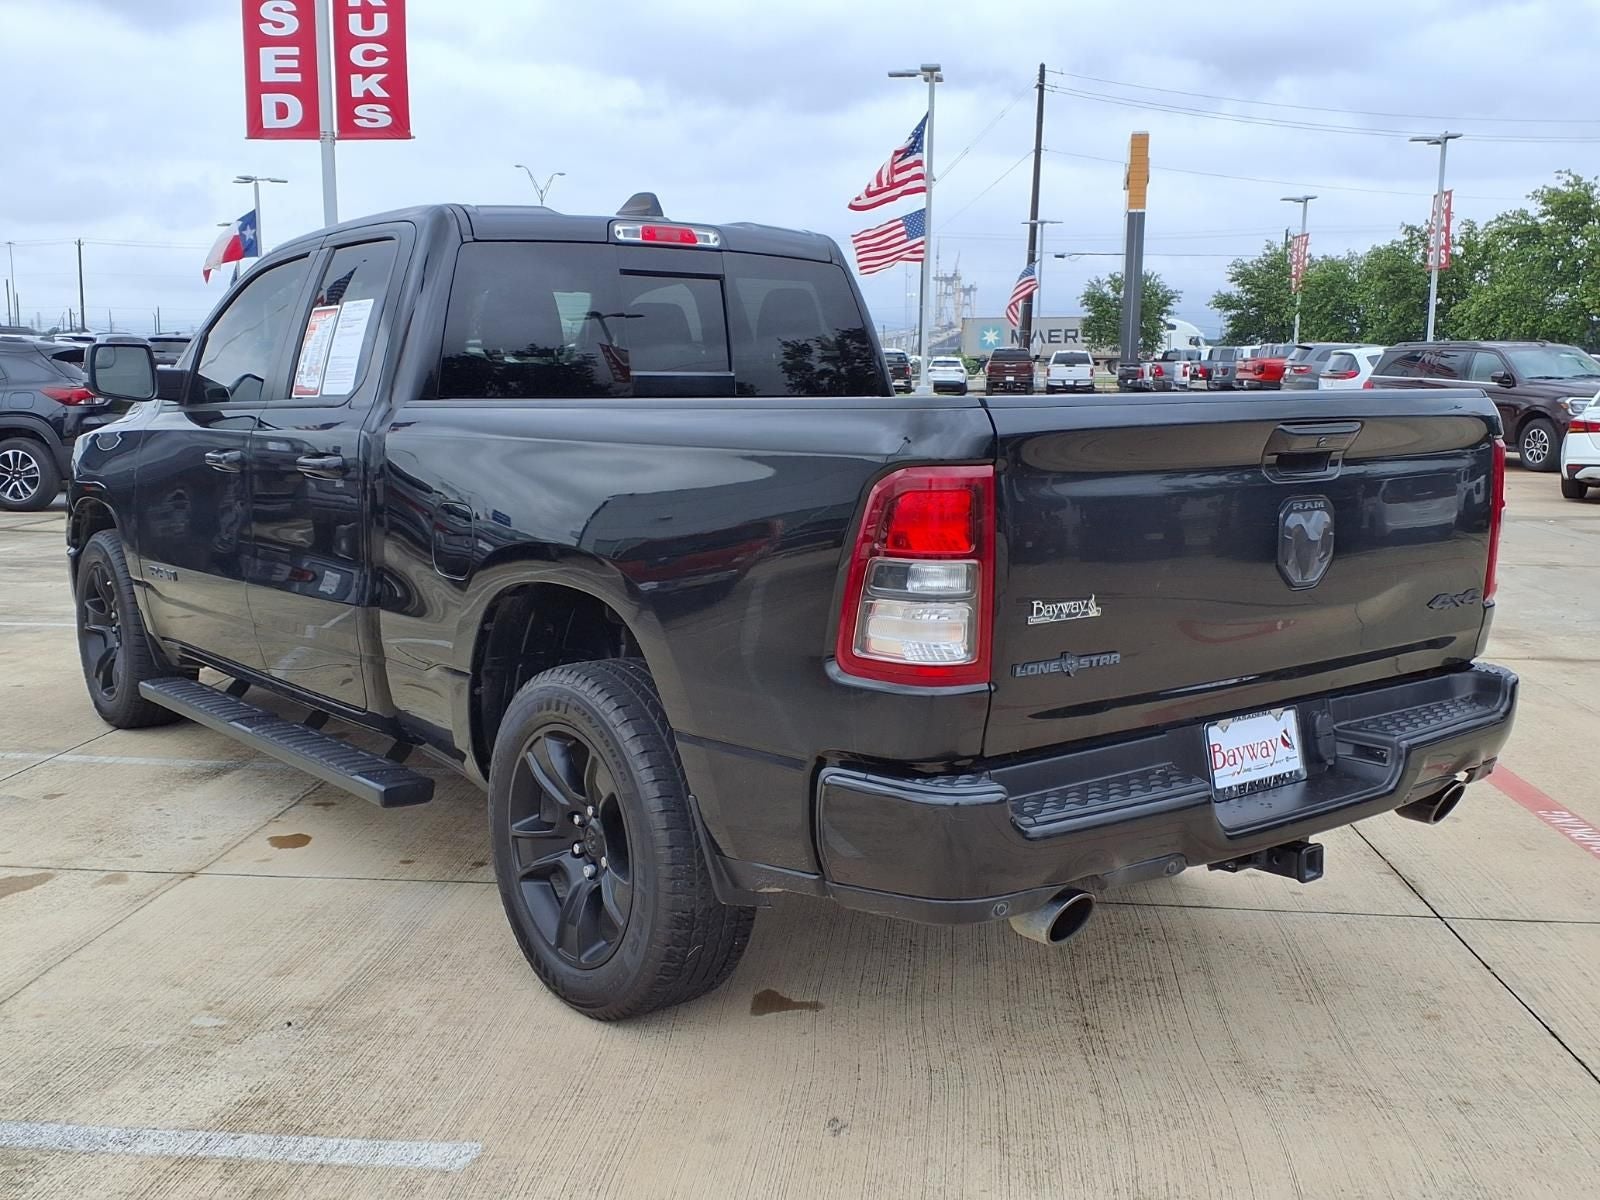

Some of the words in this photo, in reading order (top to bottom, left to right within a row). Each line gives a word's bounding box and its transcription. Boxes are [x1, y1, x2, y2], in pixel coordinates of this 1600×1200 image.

[347, 0, 393, 129] UCKS
[1292, 501, 1325, 510] RAM
[1031, 600, 1088, 621] Bayway
[1013, 661, 1062, 678] LONE
[1078, 653, 1121, 670] STAR
[1232, 710, 1272, 722] PASADENA
[1210, 737, 1278, 775] Bayway
